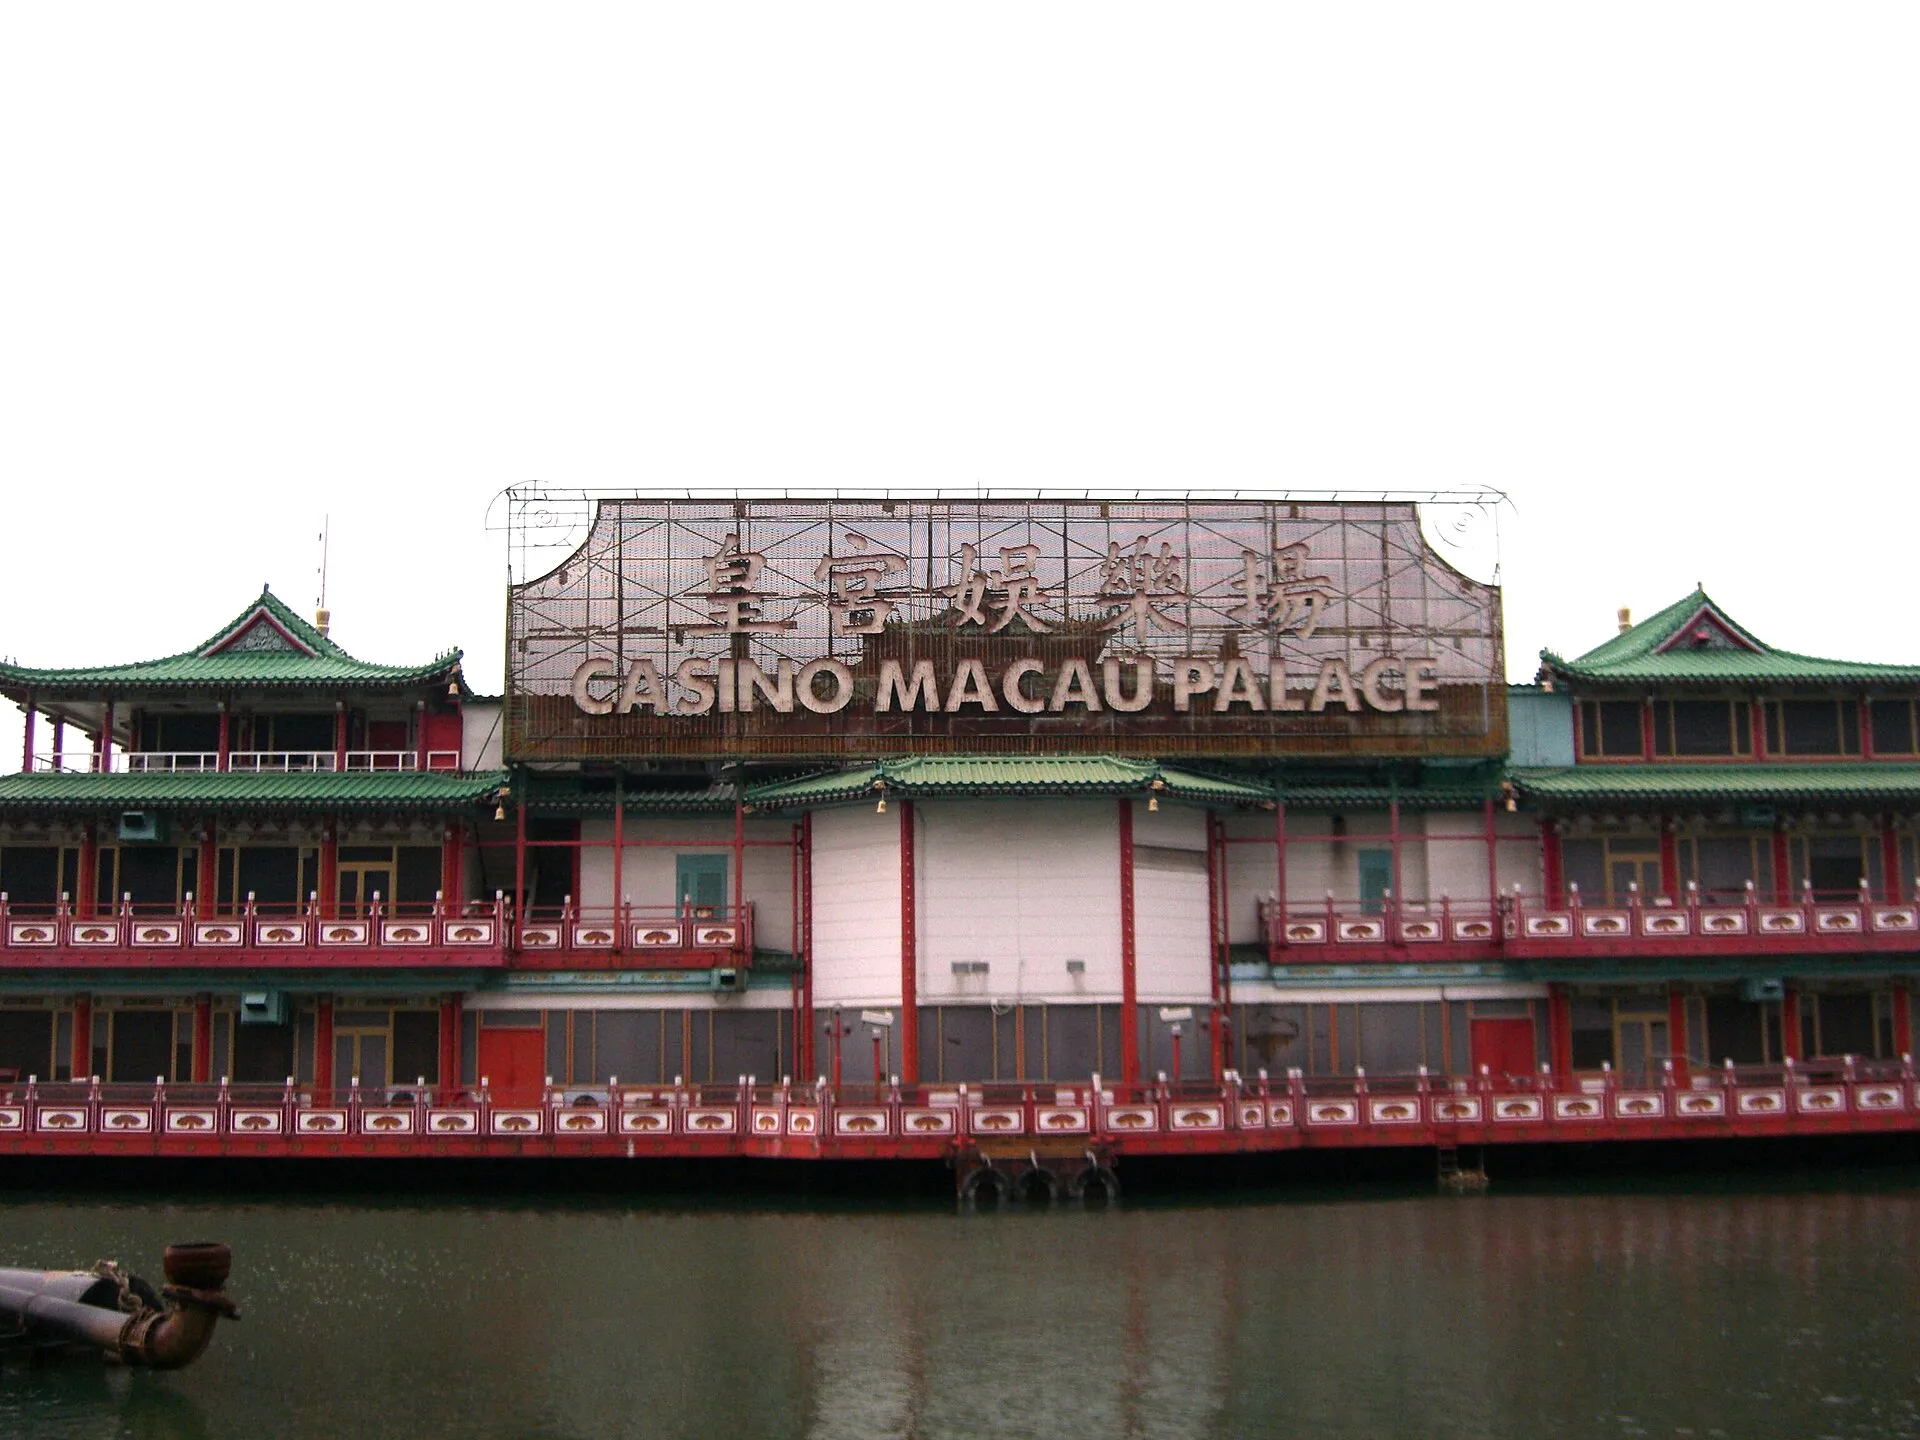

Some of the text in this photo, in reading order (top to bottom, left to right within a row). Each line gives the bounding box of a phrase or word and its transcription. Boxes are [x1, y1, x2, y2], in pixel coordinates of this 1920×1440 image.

[572, 656, 1441, 715] CASINO MACAU PALACE
